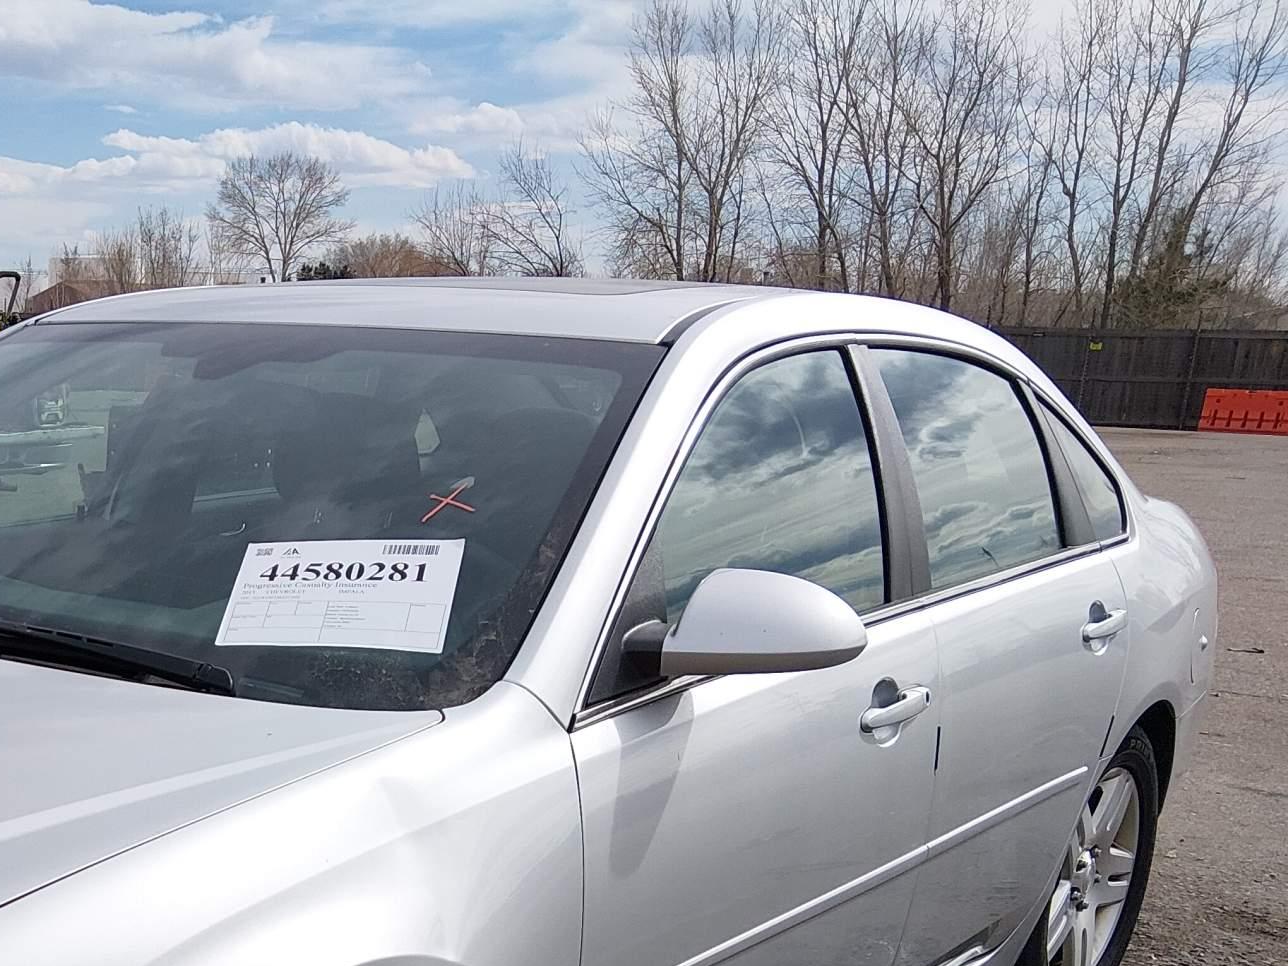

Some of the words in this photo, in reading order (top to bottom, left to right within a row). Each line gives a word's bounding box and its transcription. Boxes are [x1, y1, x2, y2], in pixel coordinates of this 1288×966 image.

[259, 561, 428, 583] 44580281
[243, 582, 292, 590] Progressive
[295, 581, 332, 590] Casualty
[335, 580, 378, 589] Insurance
